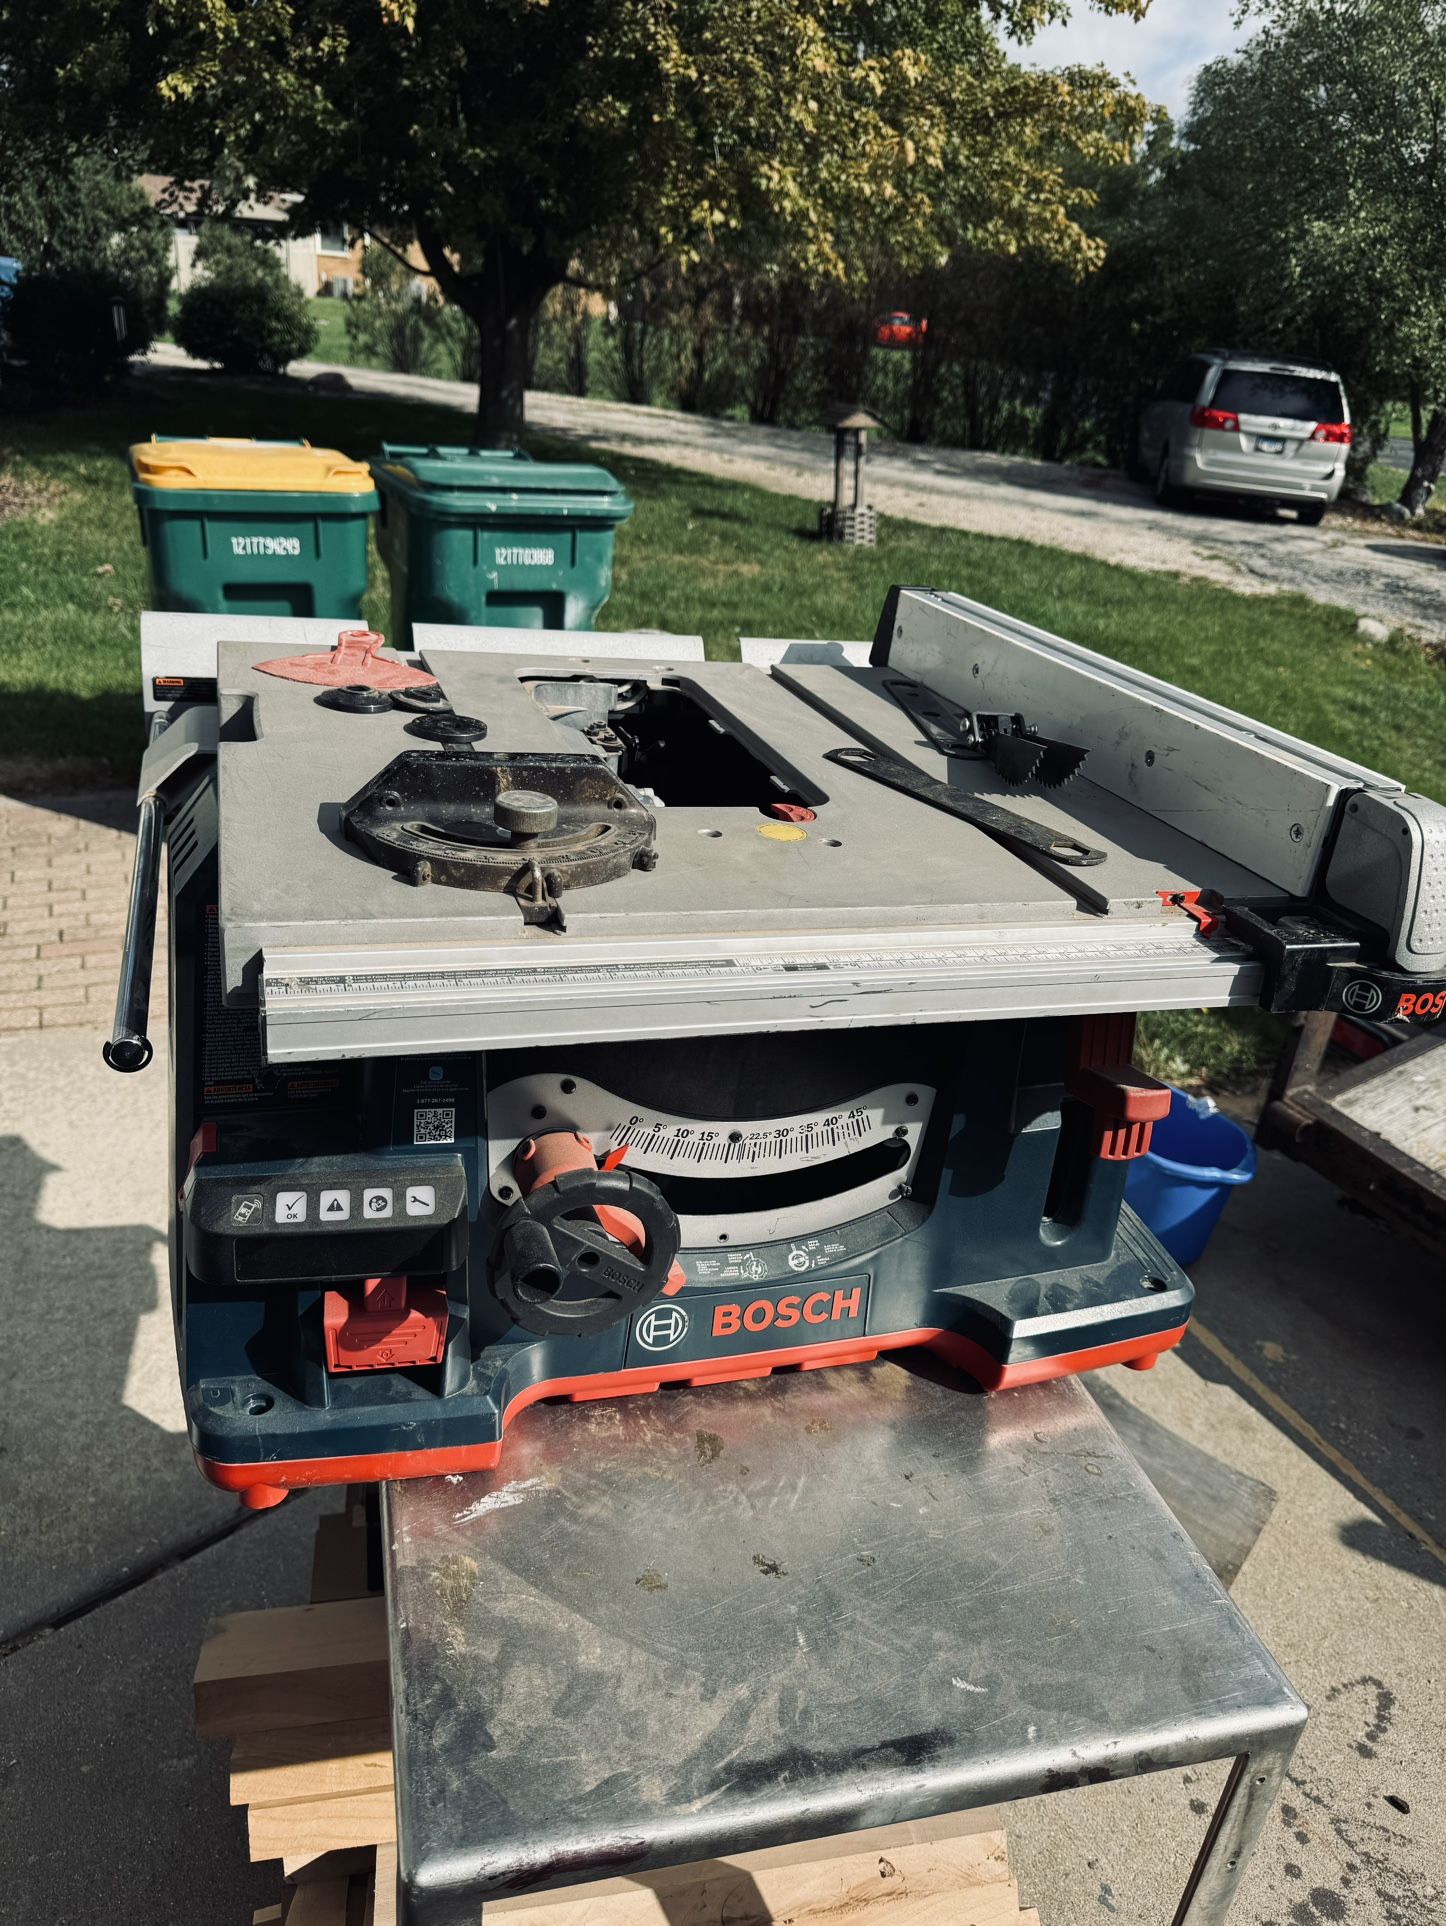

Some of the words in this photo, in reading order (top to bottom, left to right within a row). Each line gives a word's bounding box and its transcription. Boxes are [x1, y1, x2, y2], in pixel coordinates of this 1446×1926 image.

[1395, 991, 1446, 1016] BOS
[673, 1127, 695, 1139] 10°
[698, 1131, 719, 1141] 15°
[773, 1127, 795, 1139] 30°
[823, 1114, 843, 1128] 40°
[847, 1105, 868, 1120] 45°
[286, 1212, 298, 1220] OK
[602, 1265, 645, 1294] BOSCH
[711, 1287, 861, 1337] BOSCH
